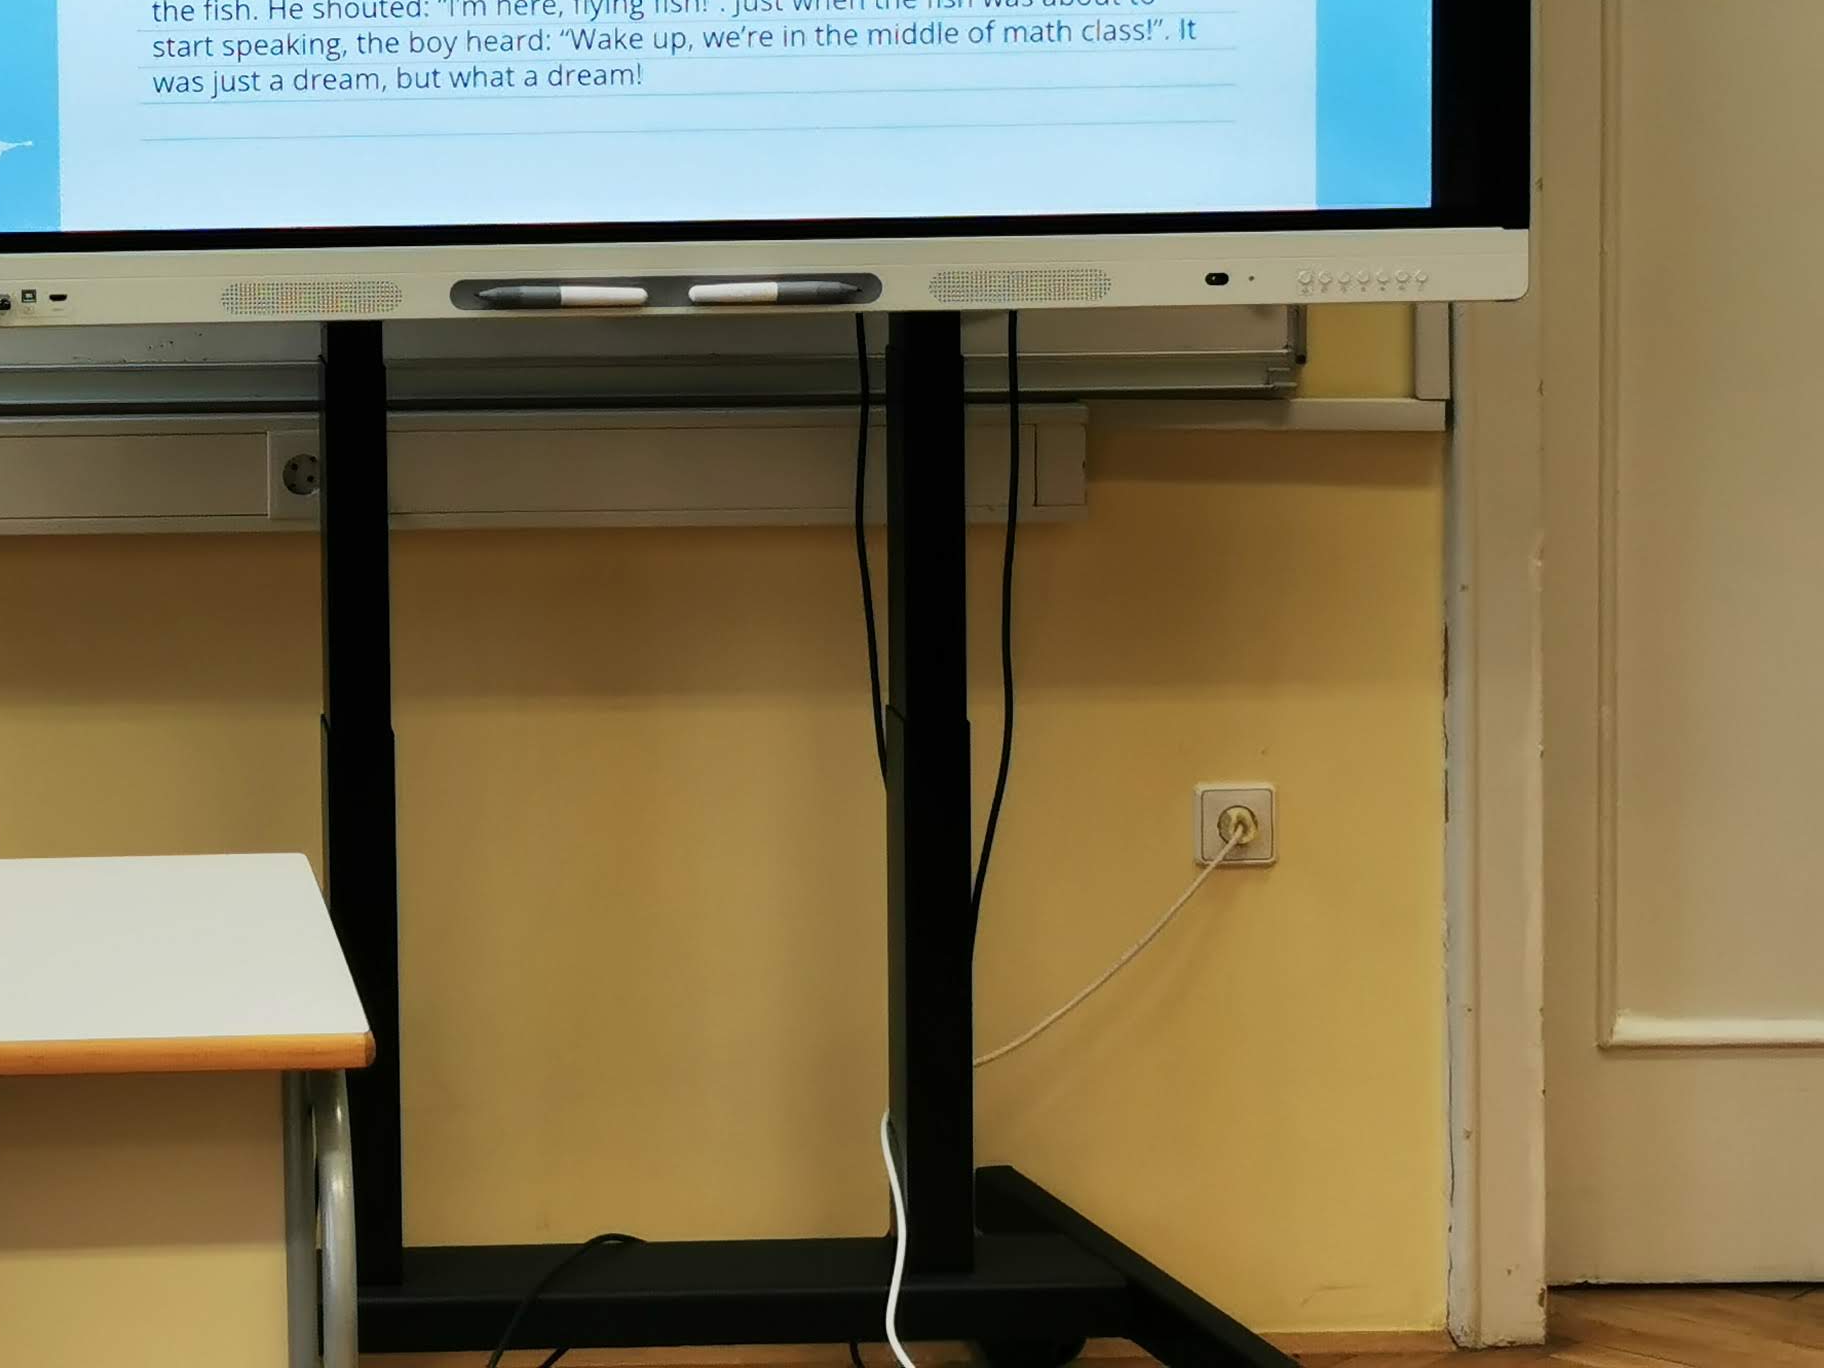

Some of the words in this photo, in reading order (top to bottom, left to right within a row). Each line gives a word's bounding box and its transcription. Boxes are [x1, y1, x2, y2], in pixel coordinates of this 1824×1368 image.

[152, 35, 215, 59] start
[221, 32, 348, 64] speaking,
[356, 31, 400, 55] the
[409, 30, 459, 60] boy
[466, 27, 551, 53] heard:
[559, 26, 644, 51] “Wake
[653, 31, 694, 57] up,
[702, 24, 774, 49] we’re
[783, 24, 806, 48] in
[814, 23, 859, 47] the
[867, 21, 960, 46] middle
[967, 19, 997, 44] of
[1003, 19, 1072, 44] math
[1081, 18, 1170, 42] class!”.
[1180, 17, 1197, 41] It
[152, 75, 205, 94] was
[210, 70, 262, 100] just
[269, 73, 284, 92] a
[292, 67, 387, 93] dream,
[396, 66, 442, 90] but
[448, 64, 516, 89] what
[523, 69, 538, 88] a
[546, 62, 642, 87] dream!
